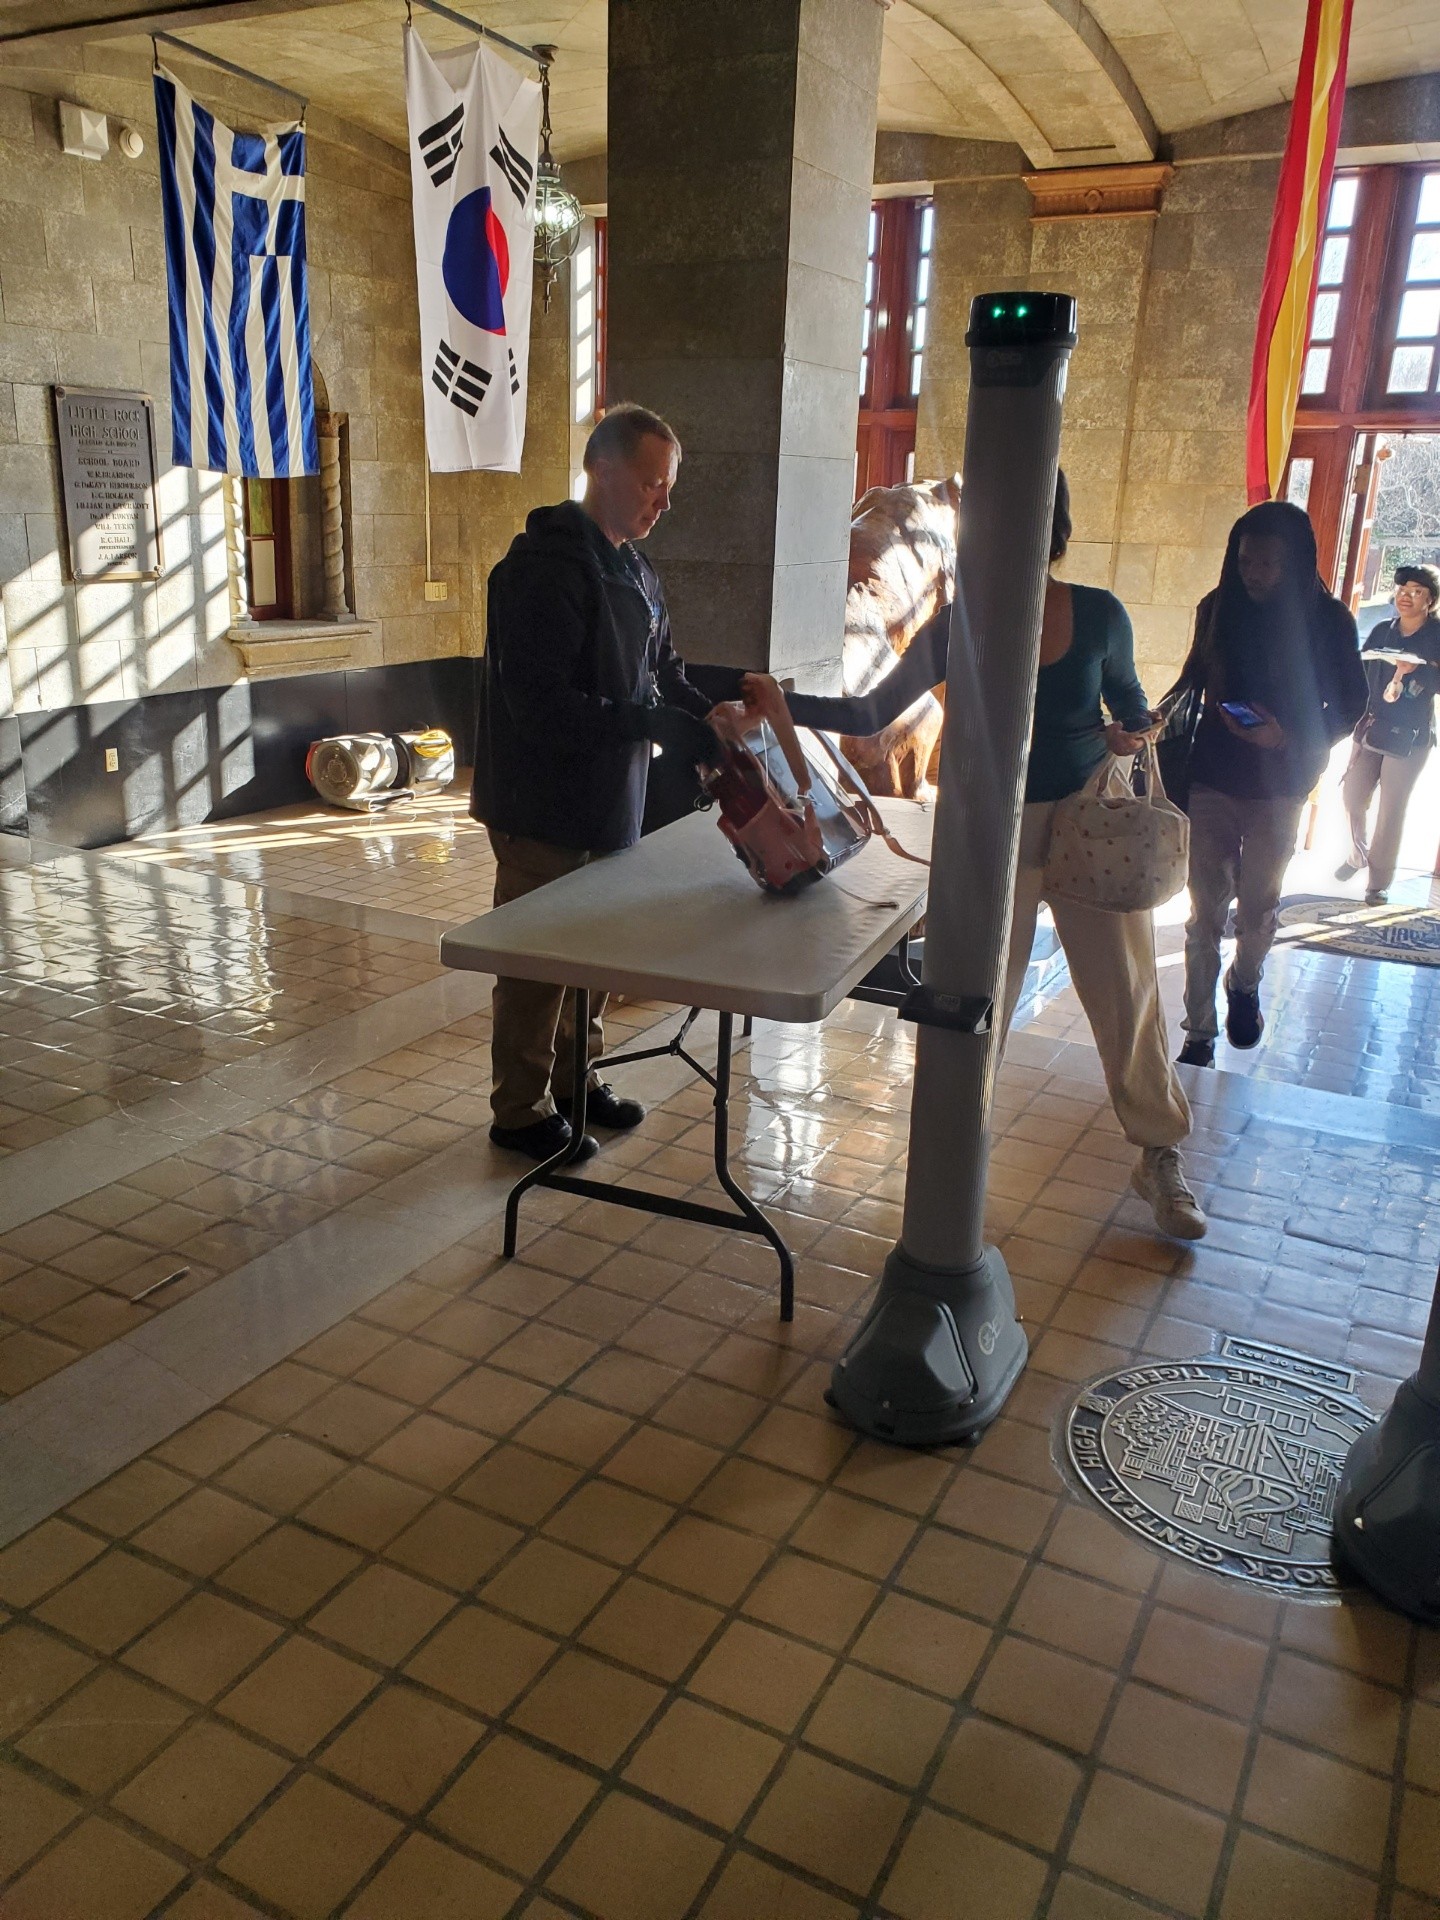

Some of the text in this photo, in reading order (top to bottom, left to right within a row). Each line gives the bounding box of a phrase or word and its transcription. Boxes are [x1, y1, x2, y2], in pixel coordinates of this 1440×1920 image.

[68, 405, 140, 422] LITTLE ROCK
[70, 424, 143, 440] HIGH SCHOOL
[78, 458, 140, 467] SCHOOL BOARD
[1271, 1357, 1288, 1368] OF
[1293, 1364, 1338, 1382] CLASS
[1118, 1366, 1344, 1414] OF THE TIGERS
[1073, 1424, 1339, 1586] ROCK CENTRAL HIGH
